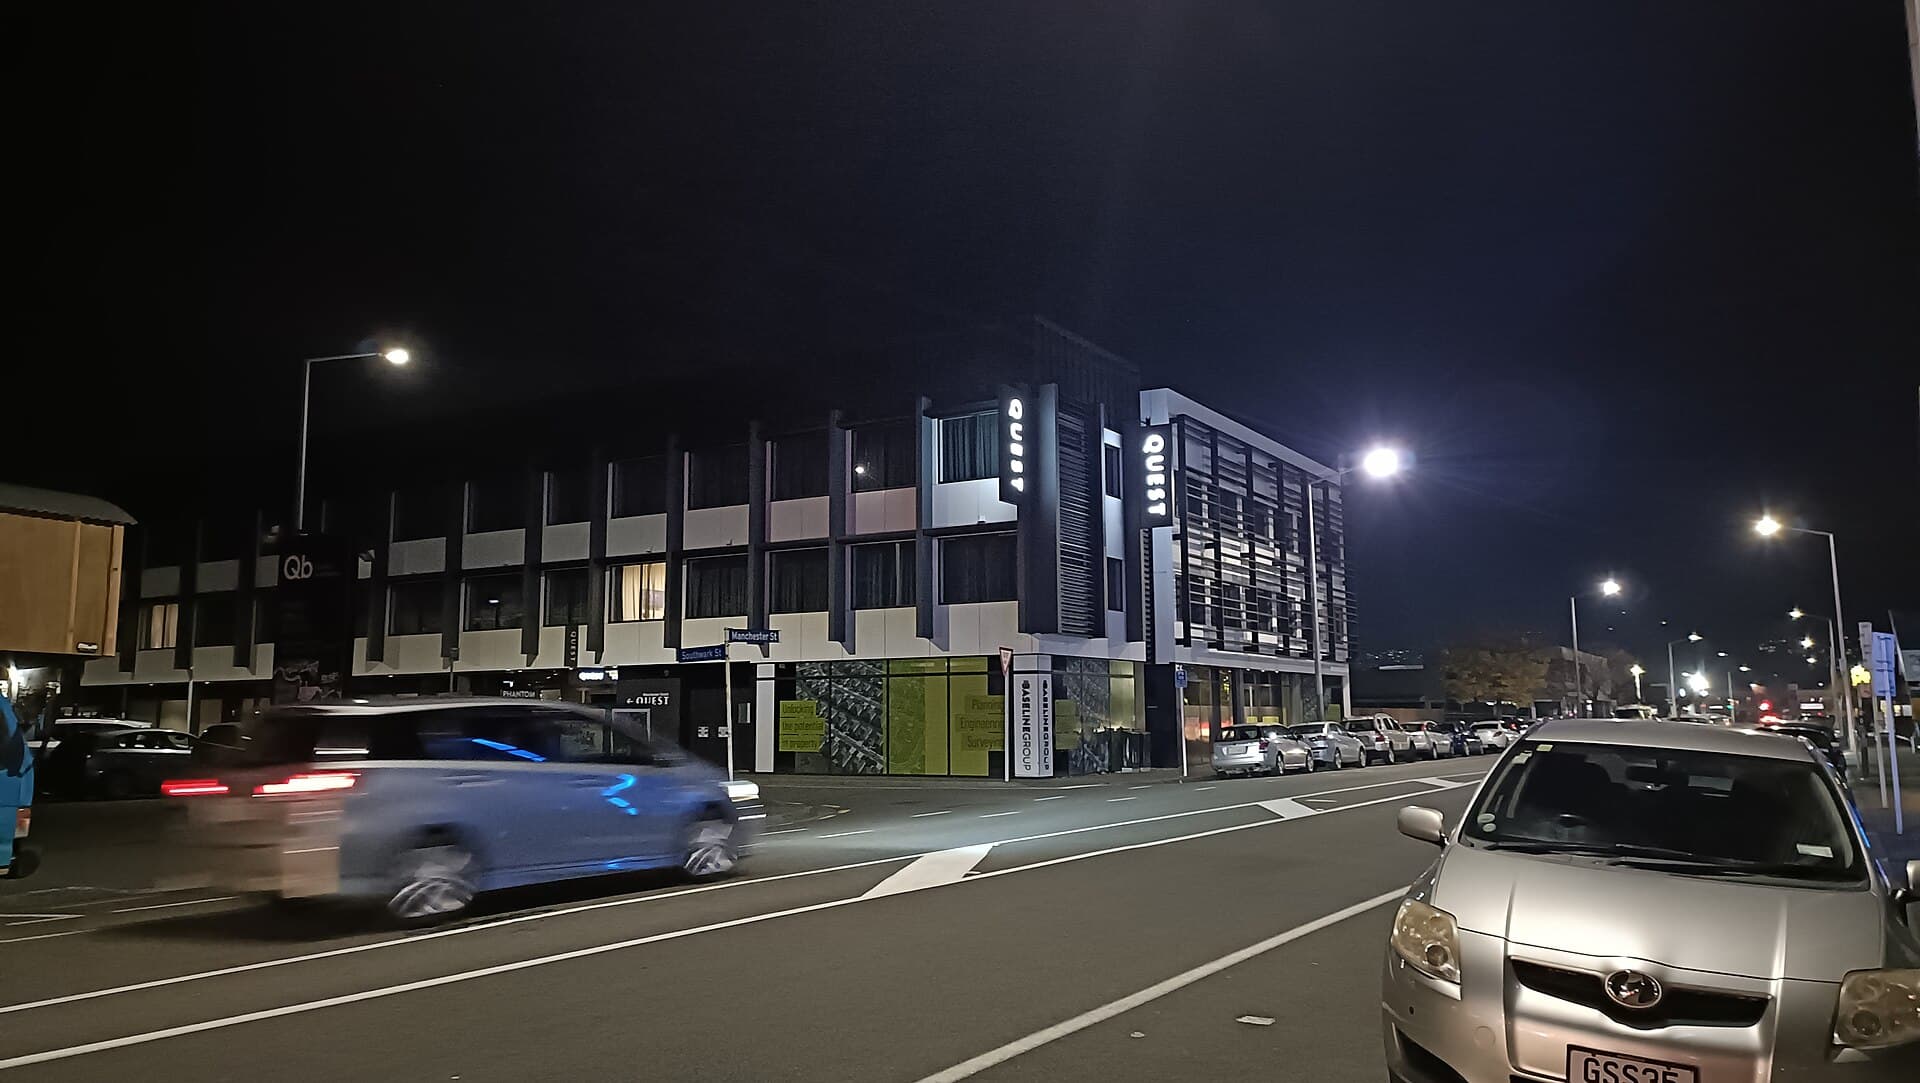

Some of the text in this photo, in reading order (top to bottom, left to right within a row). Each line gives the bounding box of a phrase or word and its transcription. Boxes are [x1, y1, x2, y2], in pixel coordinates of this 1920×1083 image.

[1142, 434, 1166, 516] QUEST
[284, 554, 313, 580] Qb
[731, 631, 777, 641] Manchester St
[681, 648, 722, 660] Southwark St
[635, 696, 669, 705] QUEST
[1021, 680, 1031, 771] BASELINEGROUP
